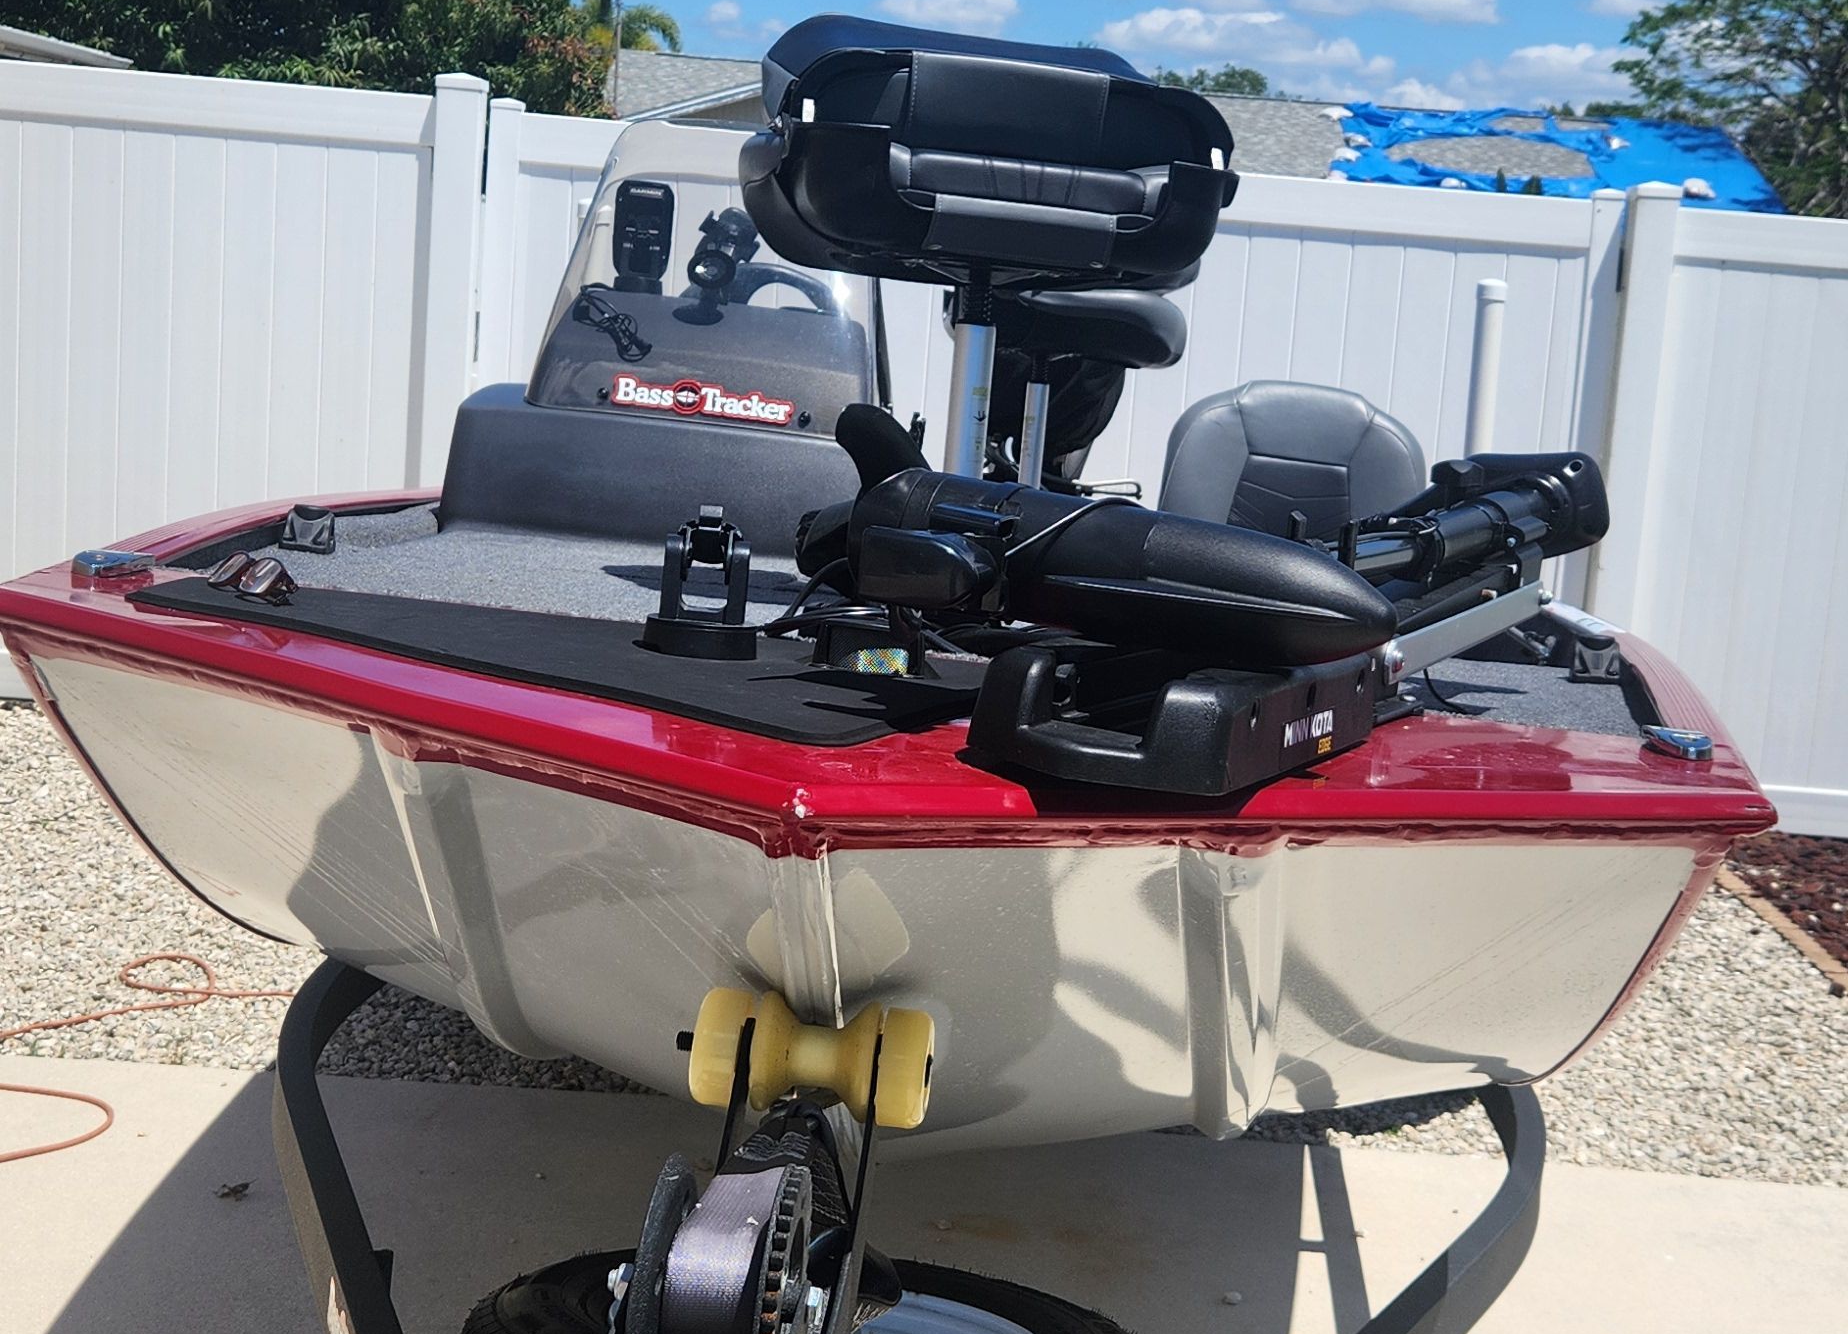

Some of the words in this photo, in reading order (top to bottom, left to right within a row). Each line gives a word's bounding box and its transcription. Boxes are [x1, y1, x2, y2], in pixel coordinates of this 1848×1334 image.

[615, 377, 674, 406] Bass
[701, 387, 790, 421] Tracker
[1284, 716, 1310, 748] MINN
[1310, 709, 1333, 739] KOTA
